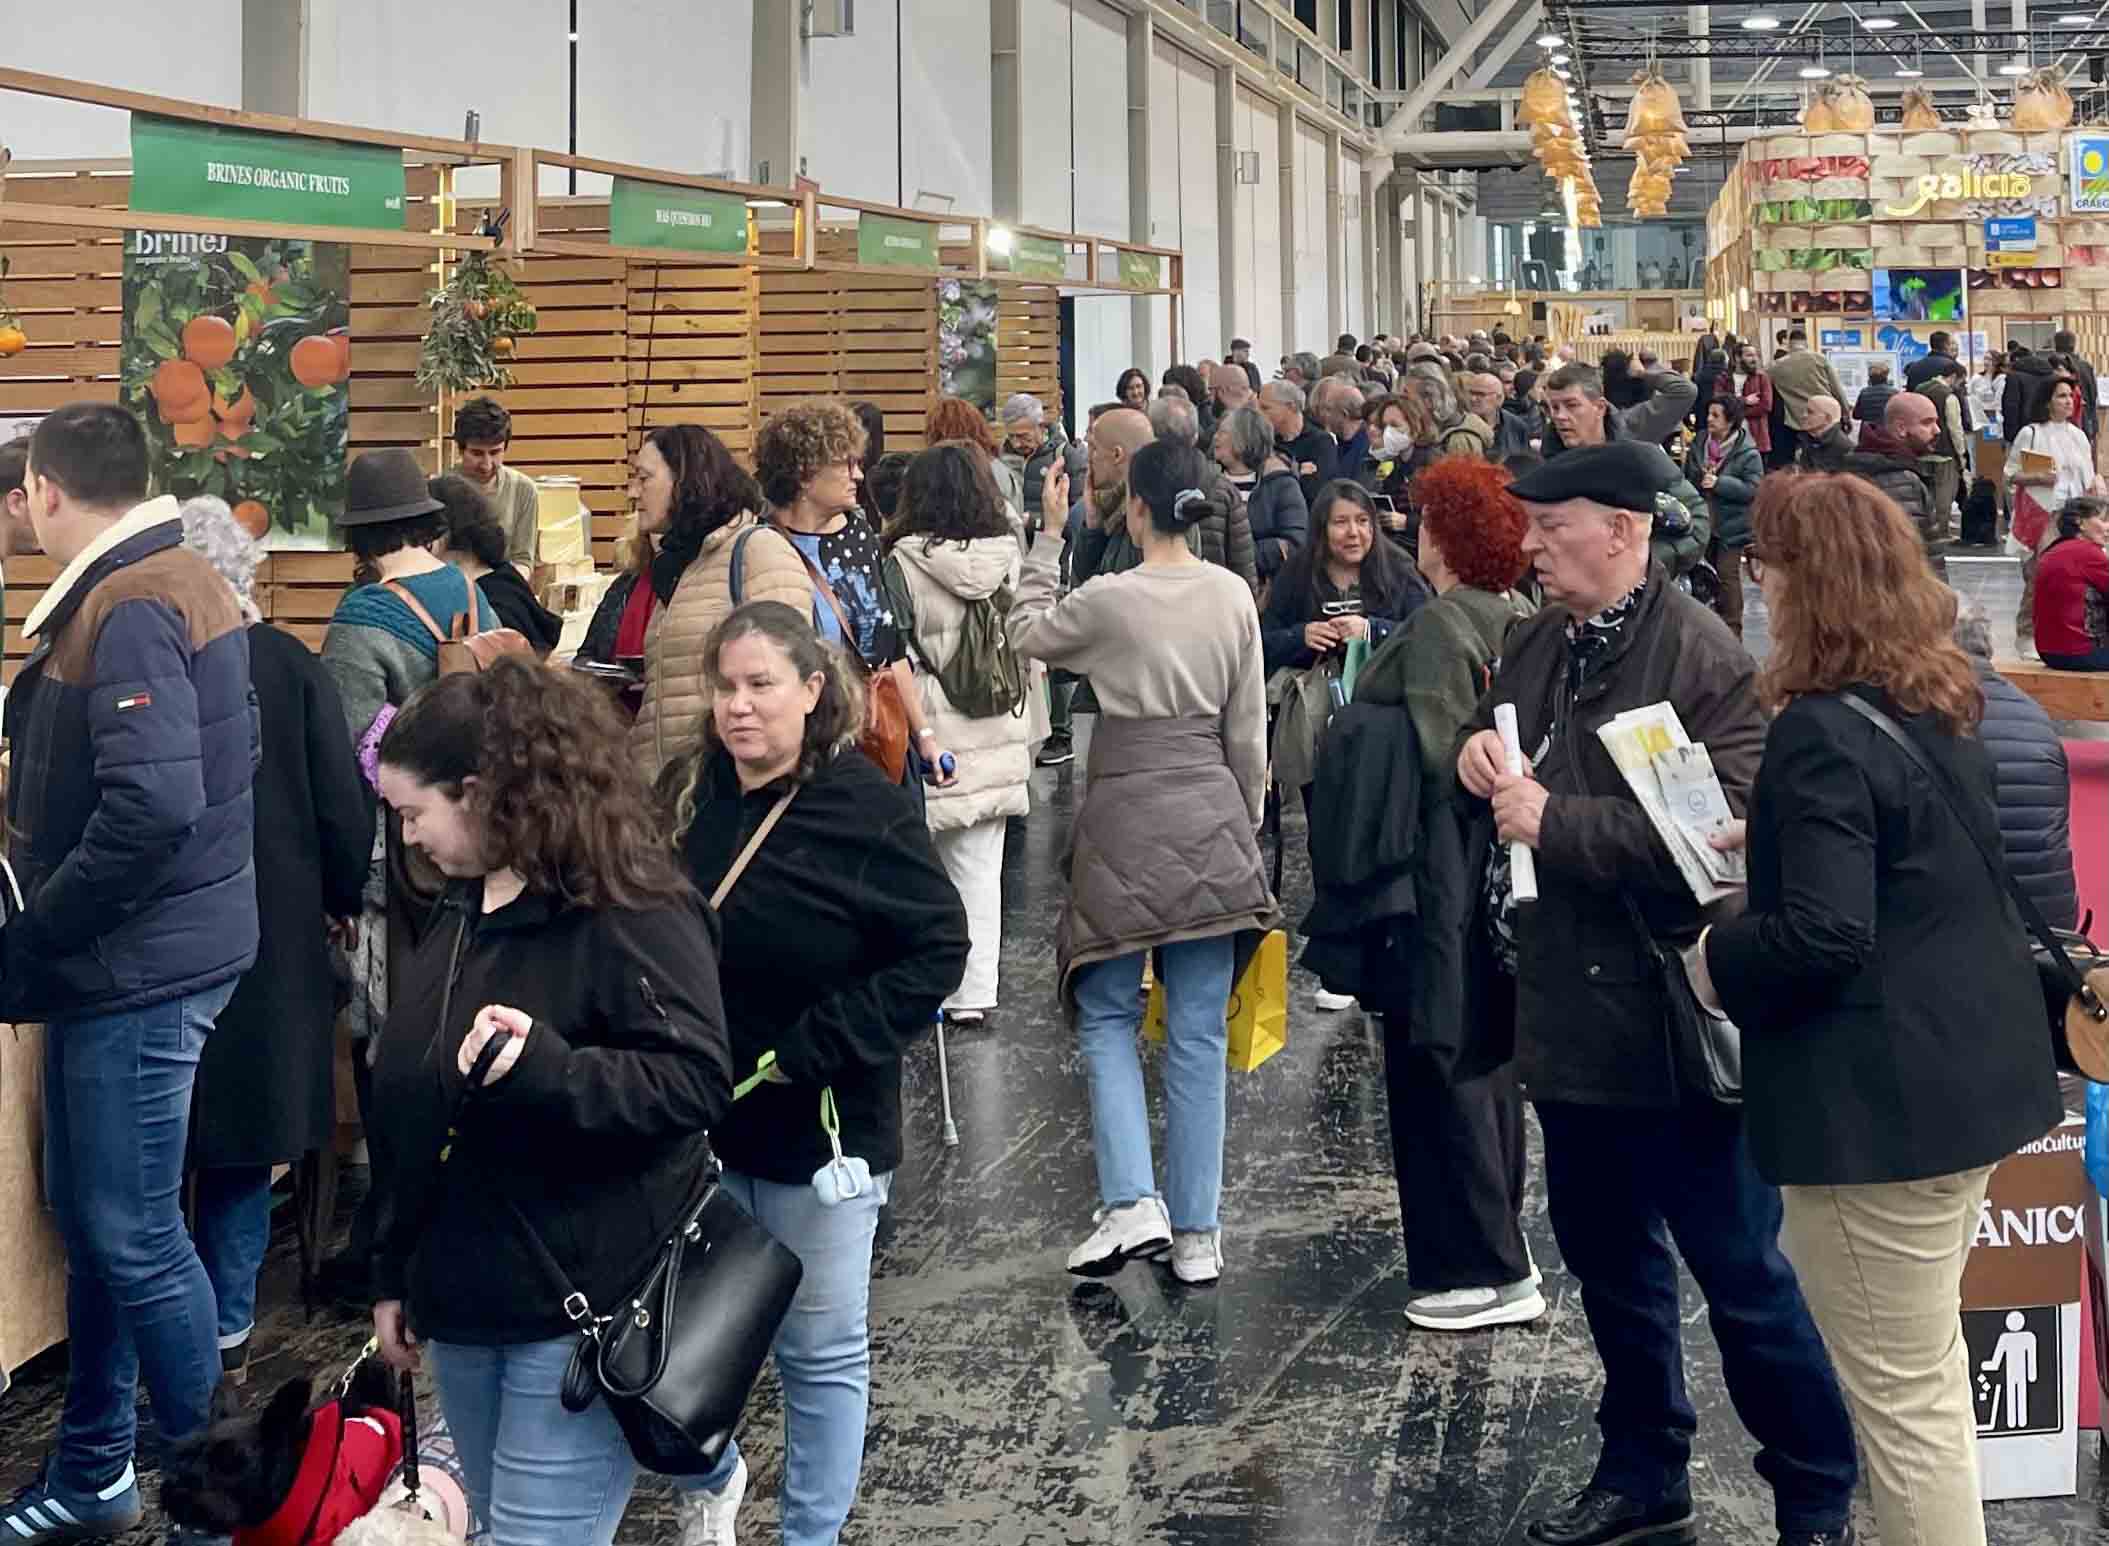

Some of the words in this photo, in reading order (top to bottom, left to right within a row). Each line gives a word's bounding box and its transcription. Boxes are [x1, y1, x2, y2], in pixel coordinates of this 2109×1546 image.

[207, 162, 253, 186] BRINES
[253, 167, 308, 192] ORGANIC
[309, 173, 350, 196] FRUITS
[1885, 167, 2032, 216] galicia
